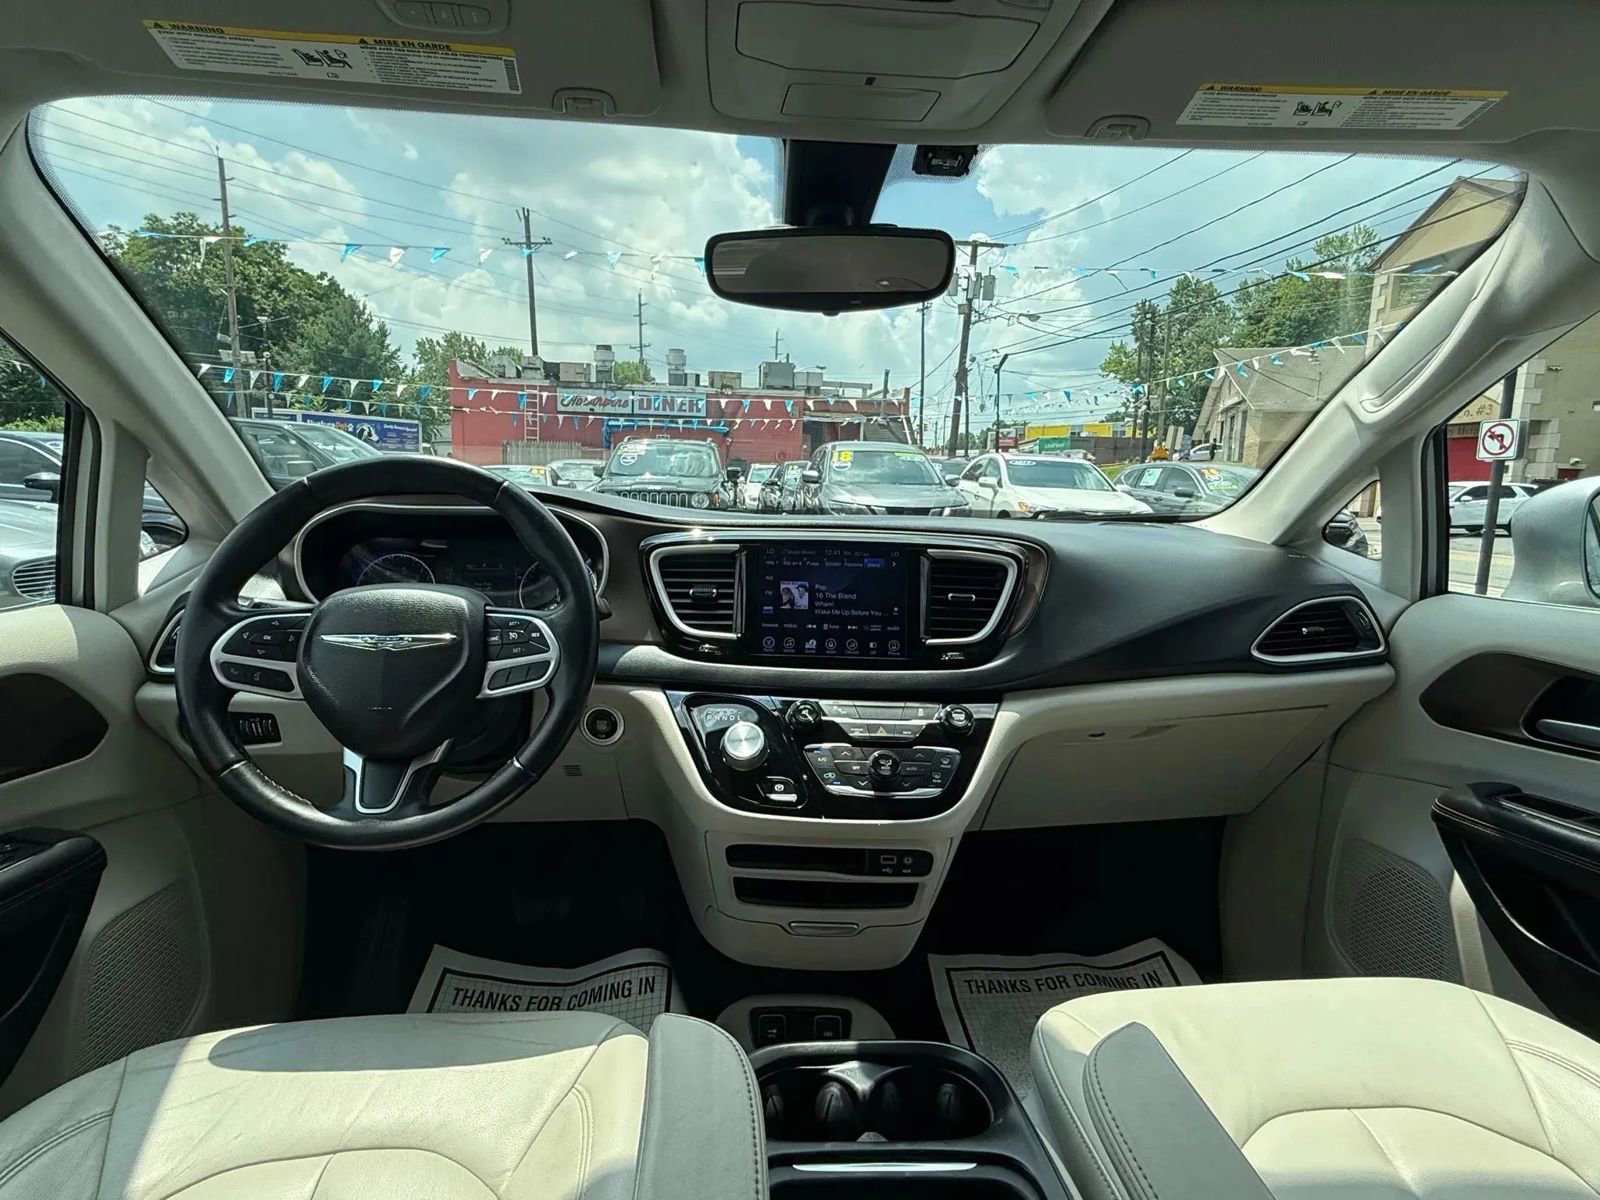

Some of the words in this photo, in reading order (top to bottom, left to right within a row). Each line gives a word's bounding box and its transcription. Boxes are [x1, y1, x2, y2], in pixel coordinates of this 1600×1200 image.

[168, 23, 224, 34] WARNING
[373, 39, 401, 47] MISE
[417, 42, 452, 51] GARDE
[1476, 404, 1493, 416] #3
[964, 978, 1032, 995] THANKS
[1034, 975, 1071, 992] FOR
[1075, 973, 1141, 989] COMING
[1142, 969, 1163, 988] IN
[451, 986, 521, 1012] THANKS
[524, 995, 562, 1012] FOR
[566, 980, 633, 1011] COMING
[638, 976, 656, 996] IN
